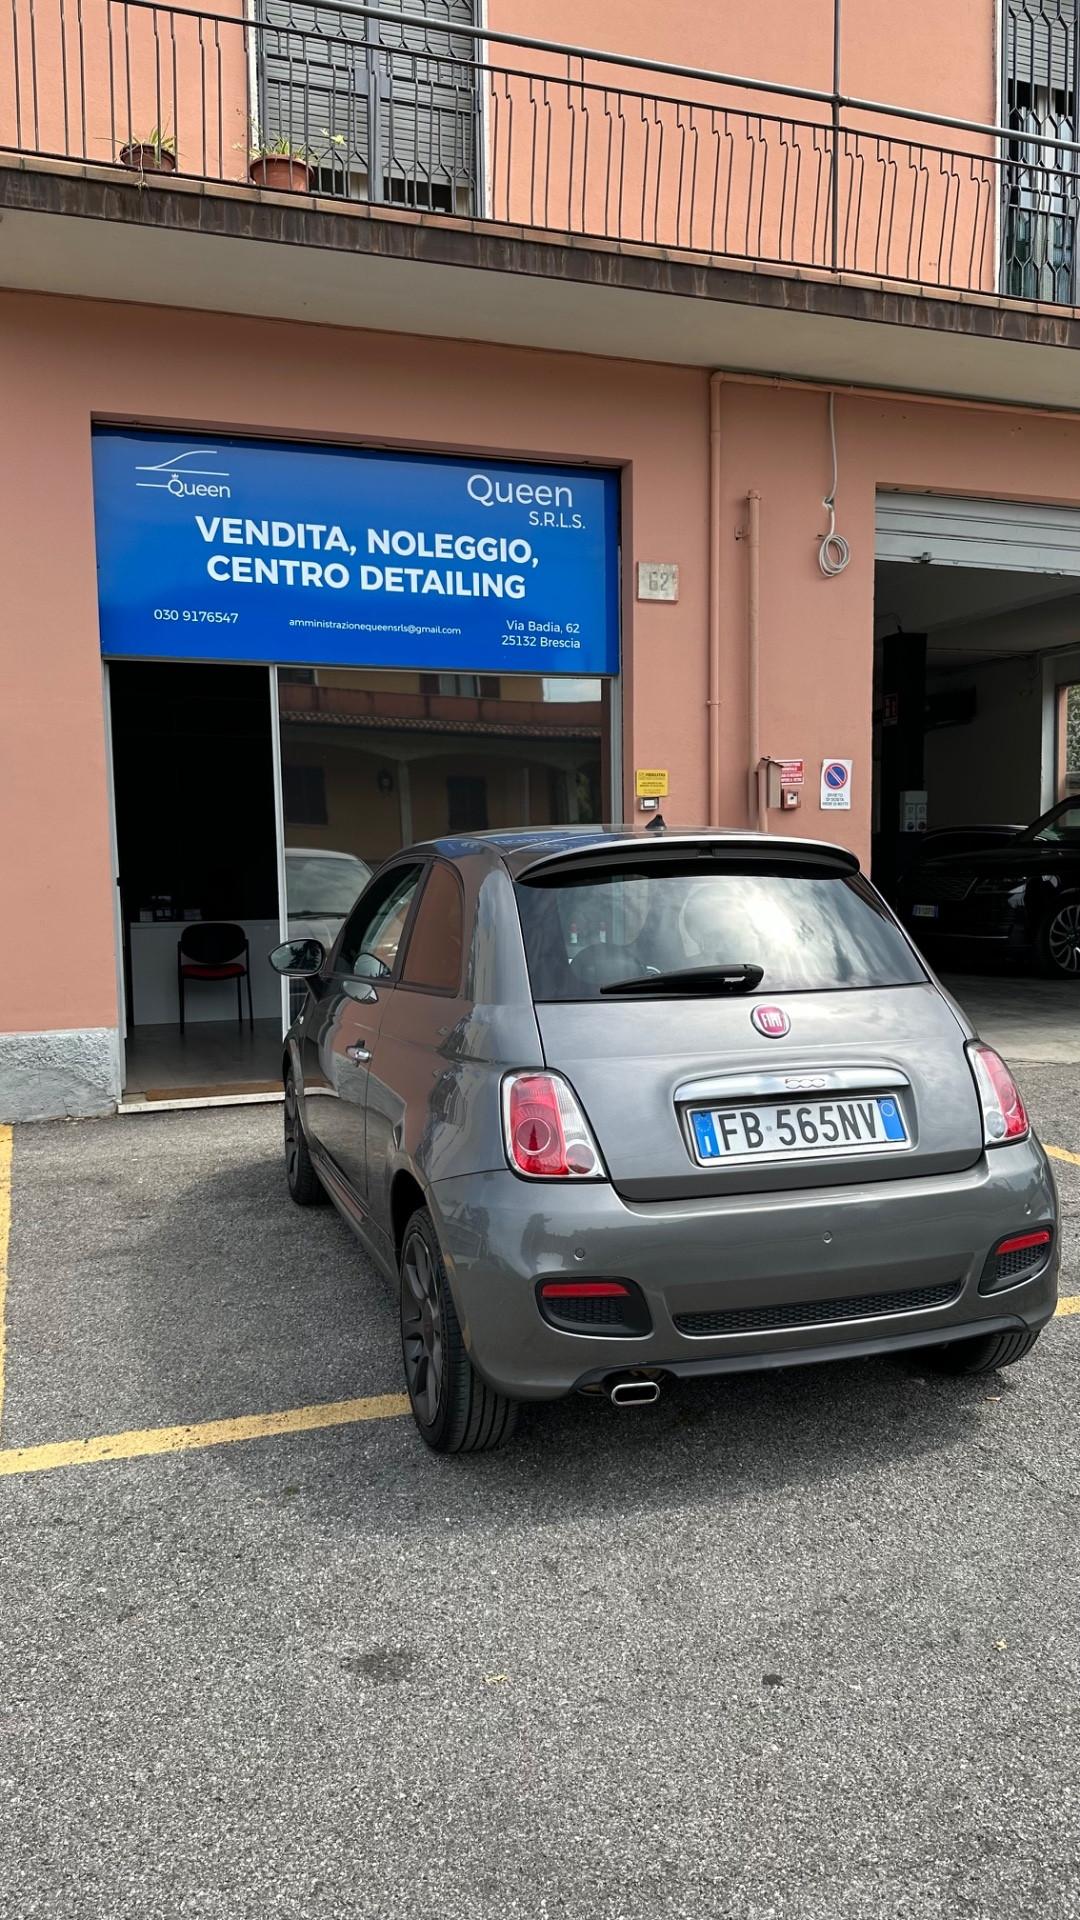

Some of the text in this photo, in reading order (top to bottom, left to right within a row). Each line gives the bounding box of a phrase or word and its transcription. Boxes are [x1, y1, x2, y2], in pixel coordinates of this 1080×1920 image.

[168, 478, 231, 499] Queen
[466, 474, 573, 507] Queen
[528, 510, 586, 530] S.R.L.S.
[195, 515, 539, 569] VENDITA, NOLEGGIO,
[206, 554, 526, 599] CENTRO DETAILING
[153, 608, 239, 624] 030 9176547
[289, 618, 462, 635] amministrazionequeensrls@gmail.com
[506, 619, 580, 635] Via Badia, 62
[501, 634, 581, 649] 25132 Brescia
[760, 1012, 783, 1028] FIAT
[718, 1111, 764, 1151] FB
[776, 1102, 877, 1146] 565NV
